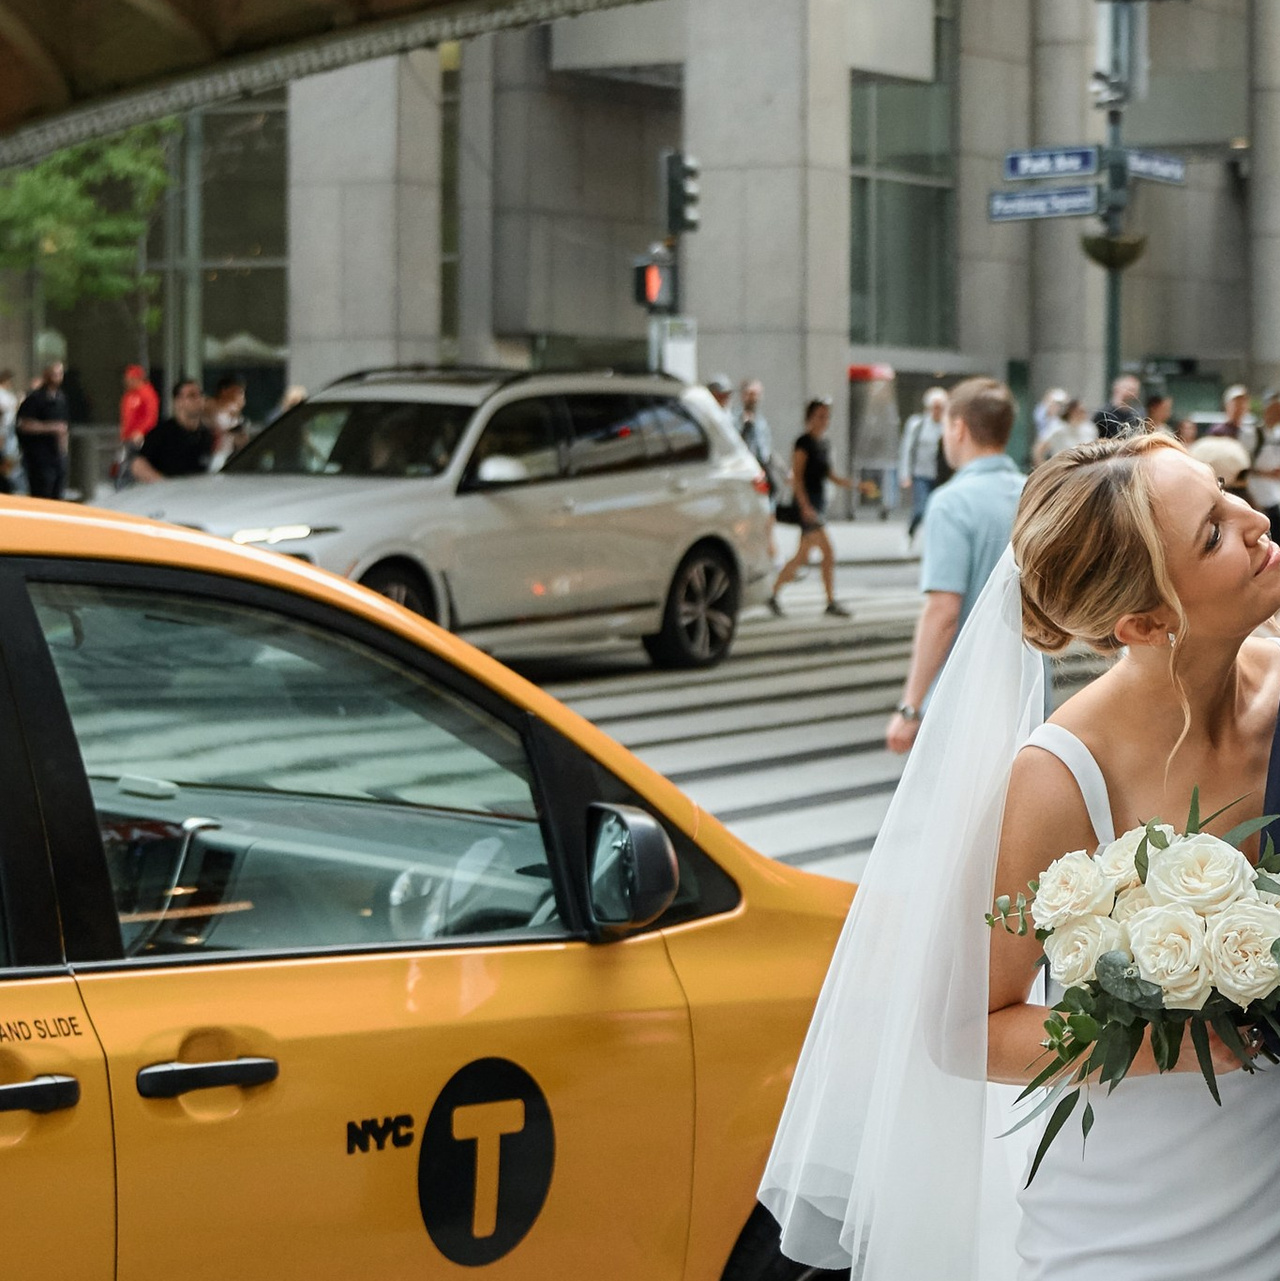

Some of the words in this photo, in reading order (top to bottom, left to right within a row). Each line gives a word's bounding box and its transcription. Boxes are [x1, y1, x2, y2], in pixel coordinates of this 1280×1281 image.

[0, 1021, 32, 1042] AND
[34, 1017, 82, 1039] SLIDE
[347, 1114, 414, 1154] NYC
[452, 1098, 525, 1238] T
